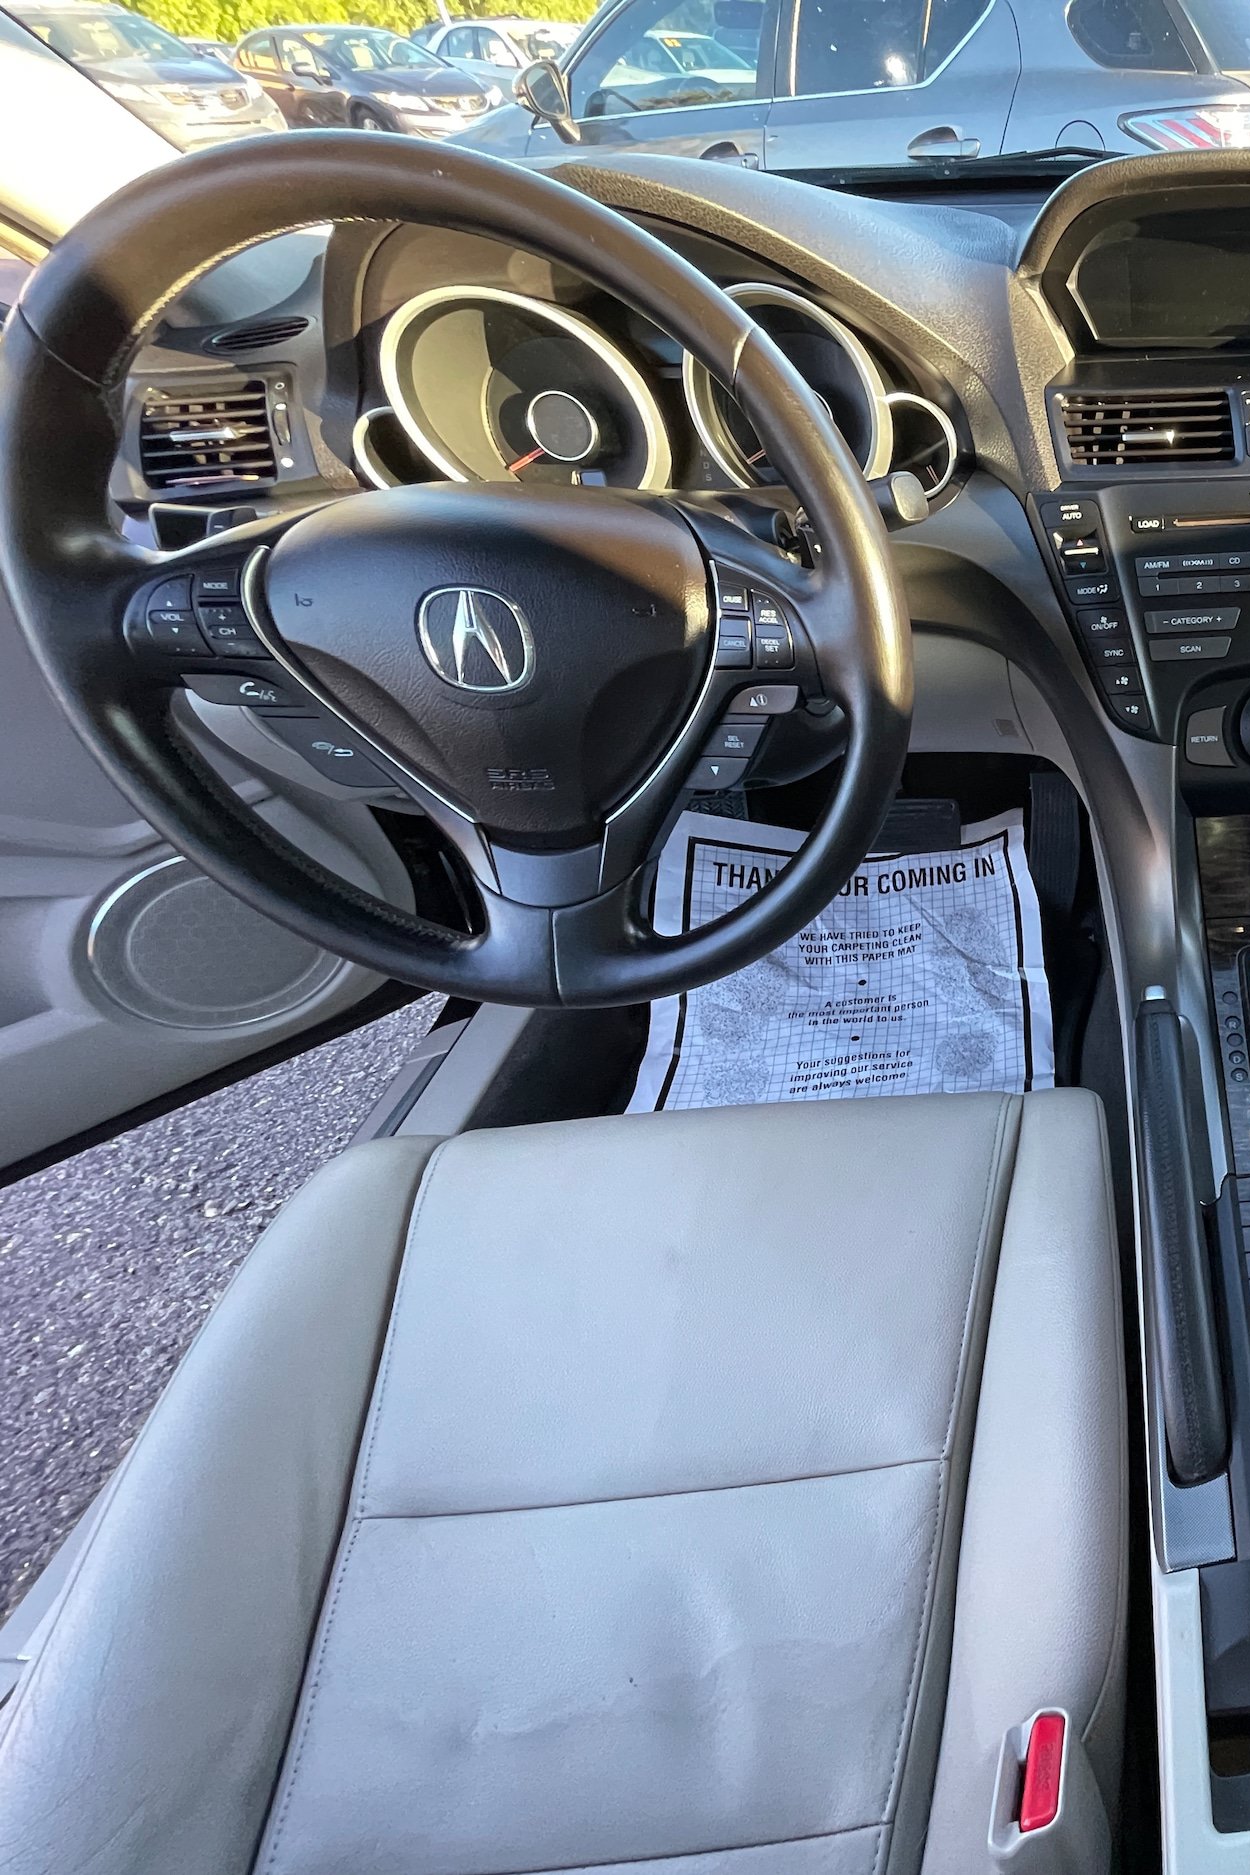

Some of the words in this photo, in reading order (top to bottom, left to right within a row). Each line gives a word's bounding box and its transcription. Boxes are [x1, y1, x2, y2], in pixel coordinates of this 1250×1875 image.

[1062, 512, 1082, 520] AUTO
[1138, 520, 1159, 528] LOAD
[1077, 587, 1096, 595] MODE
[1196, 582, 1202, 590] 2
[160, 614, 184, 622] VOL
[1170, 616, 1213, 626] CATEGORY
[1091, 622, 1118, 631] ON/OFF
[1104, 650, 1124, 658] SYNC
[1180, 646, 1202, 654] SCAN
[1190, 735, 1218, 743] RETURN
[713, 862, 779, 888] THAN
[878, 862, 967, 894] COMING
[974, 854, 996, 878] IN
[800, 932, 817, 941] WE
[820, 932, 846, 940] HAVE
[850, 931, 878, 940] TRIED
[882, 928, 895, 938] TO
[898, 923, 921, 935] KEEP
[799, 944, 828, 954] YOUR
[832, 940, 889, 952] CARPETING
[892, 934, 922, 947] CLEAN
[804, 956, 832, 965] WITH
[836, 954, 859, 964] THIS
[862, 951, 894, 962] PAPER
[898, 945, 917, 957] MAT
[836, 996, 885, 1007] customer
[840, 1004, 892, 1016] important
[894, 1000, 929, 1013] person
[822, 1017, 839, 1025] the
[843, 1015, 872, 1024] world
[796, 1060, 822, 1070] Your
[824, 1051, 892, 1067] suggestions
[896, 1050, 911, 1058] for
[790, 1067, 847, 1082] improving
[850, 1064, 869, 1074] our
[872, 1060, 913, 1071] service
[1236, 1072, 1244, 1082] S
[789, 1085, 808, 1094] are
[812, 1079, 852, 1092] always
